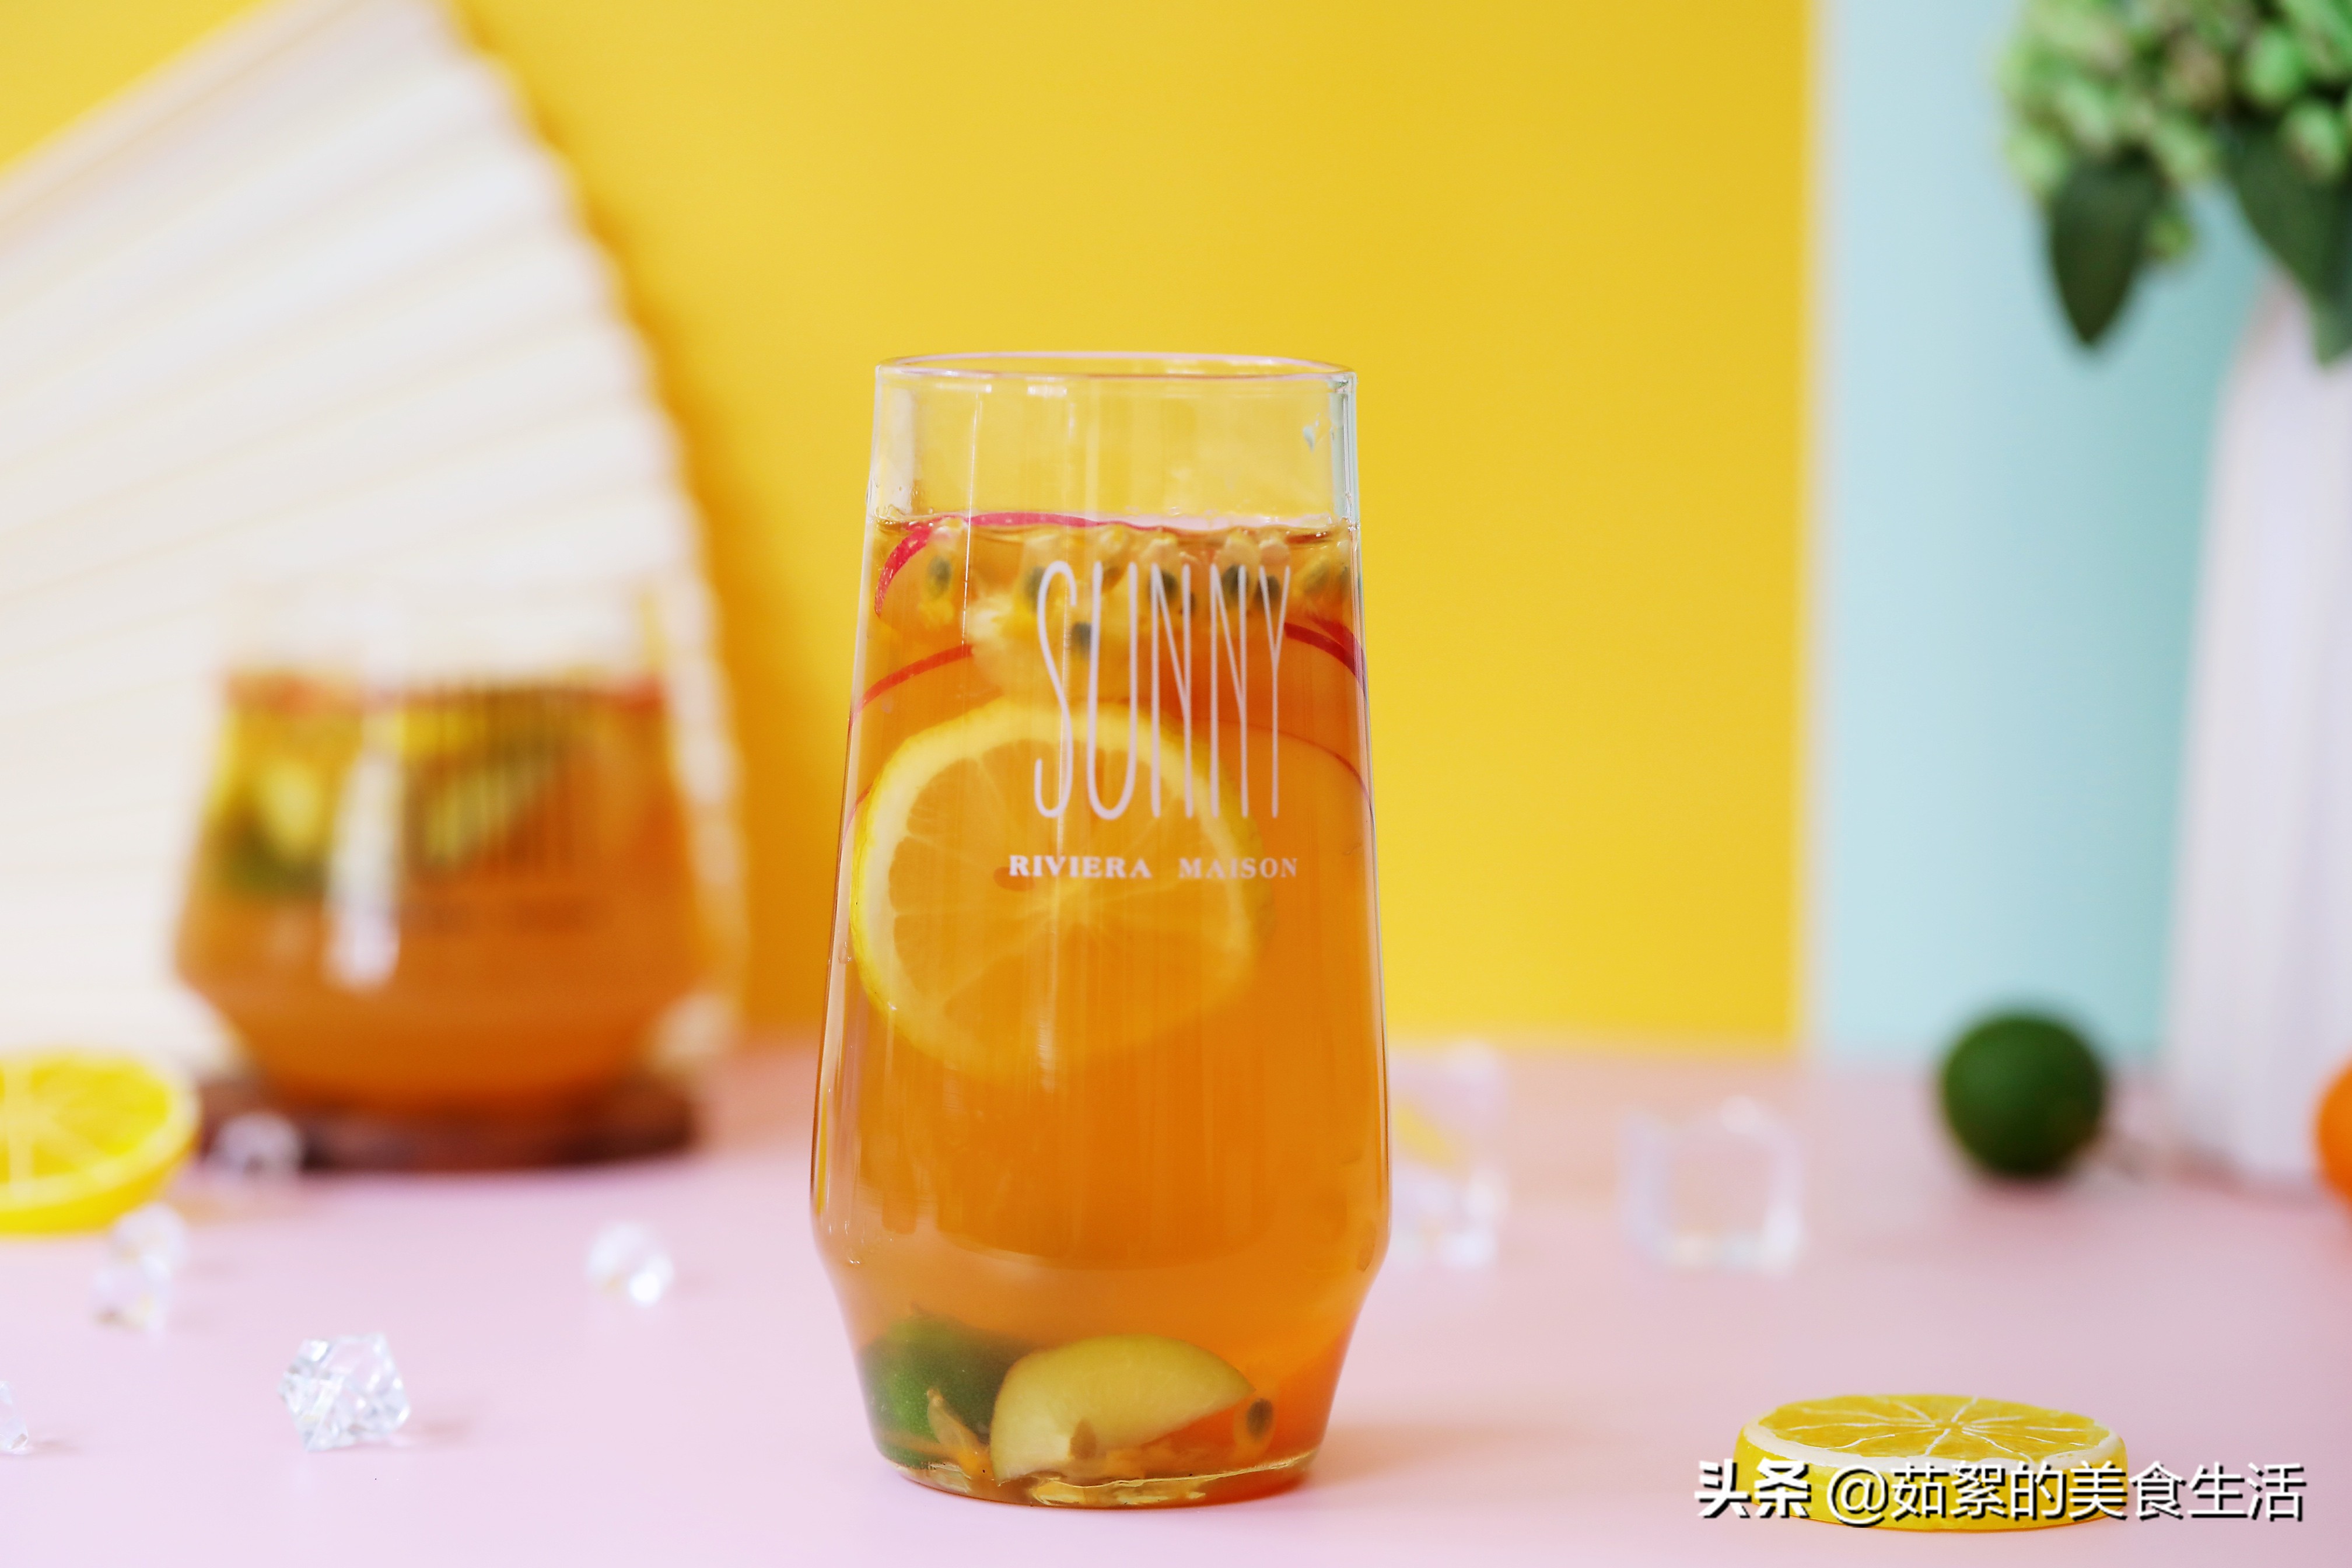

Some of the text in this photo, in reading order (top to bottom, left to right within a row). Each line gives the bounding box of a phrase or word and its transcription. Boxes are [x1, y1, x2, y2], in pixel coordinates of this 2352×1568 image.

[1034, 561, 1290, 820] SUNNY
[1009, 855, 1297, 878] RIVIERA MAISON
